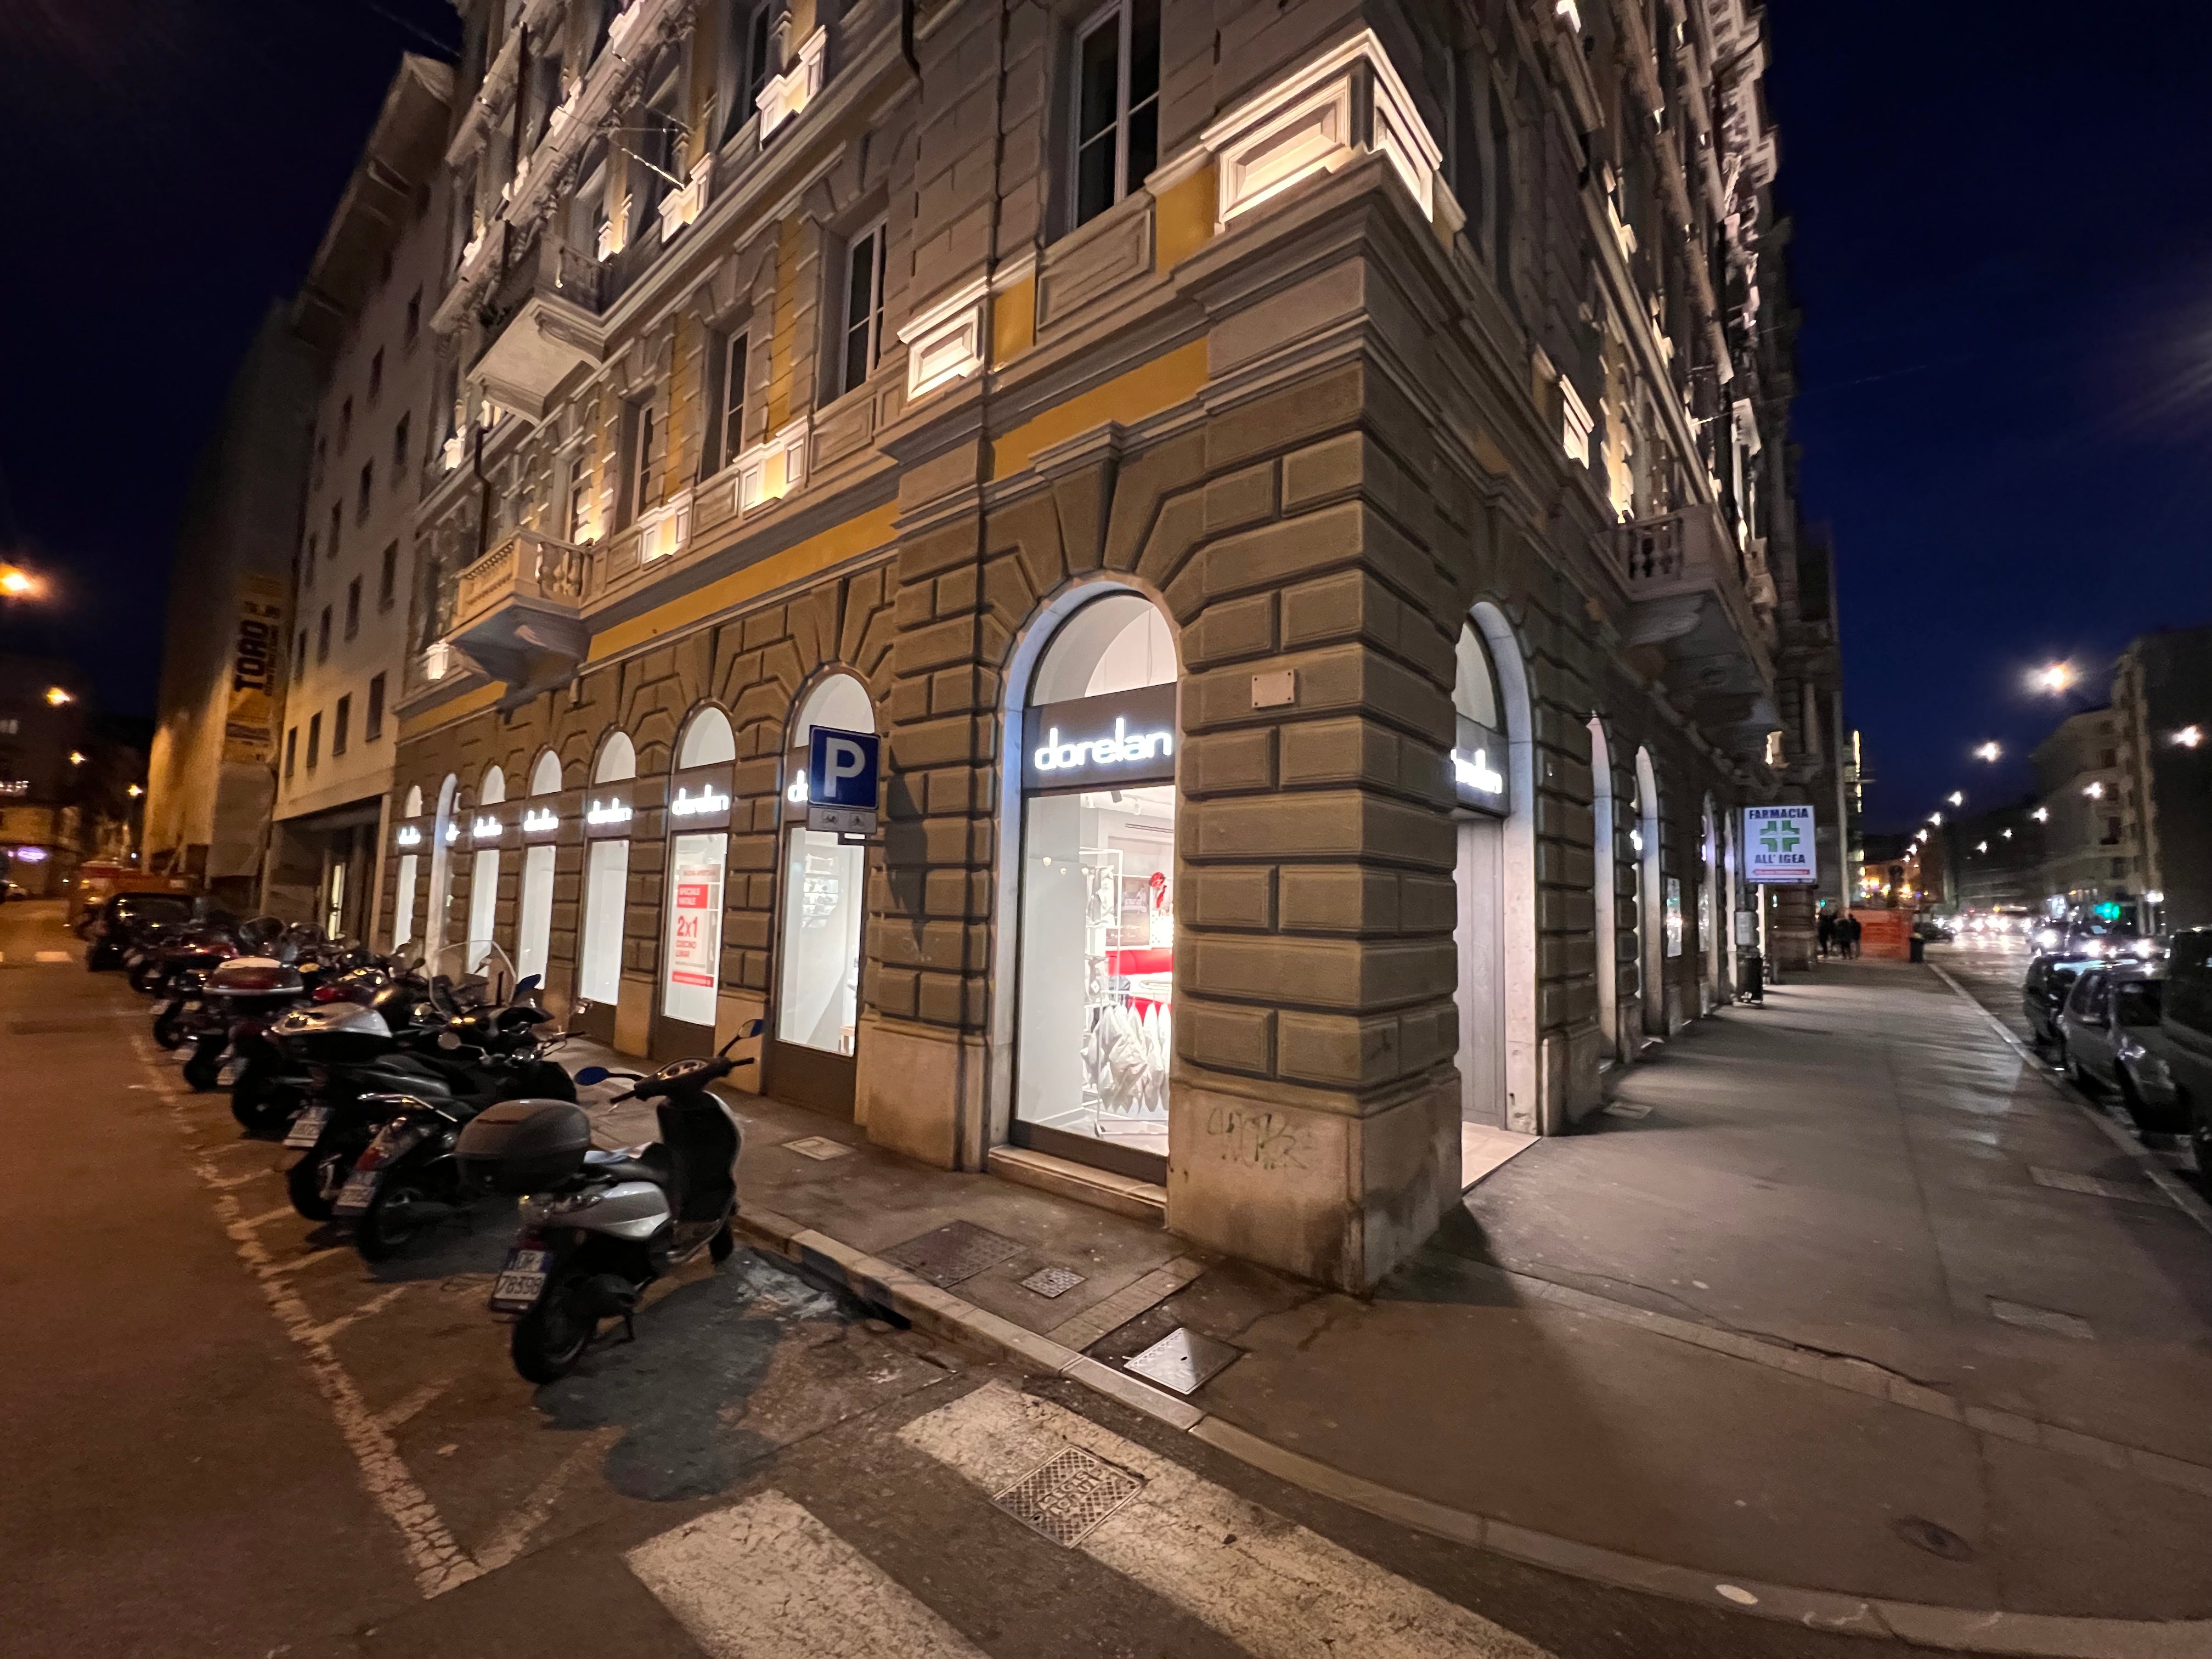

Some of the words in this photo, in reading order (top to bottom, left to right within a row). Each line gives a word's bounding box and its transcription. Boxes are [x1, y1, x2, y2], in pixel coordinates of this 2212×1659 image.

[1034, 717, 1172, 770] dorelan
[825, 737, 866, 798] P
[1749, 808, 1809, 820] FARMACIA
[1779, 854, 1805, 864] IGEA
[676, 915, 698, 938] 2x1
